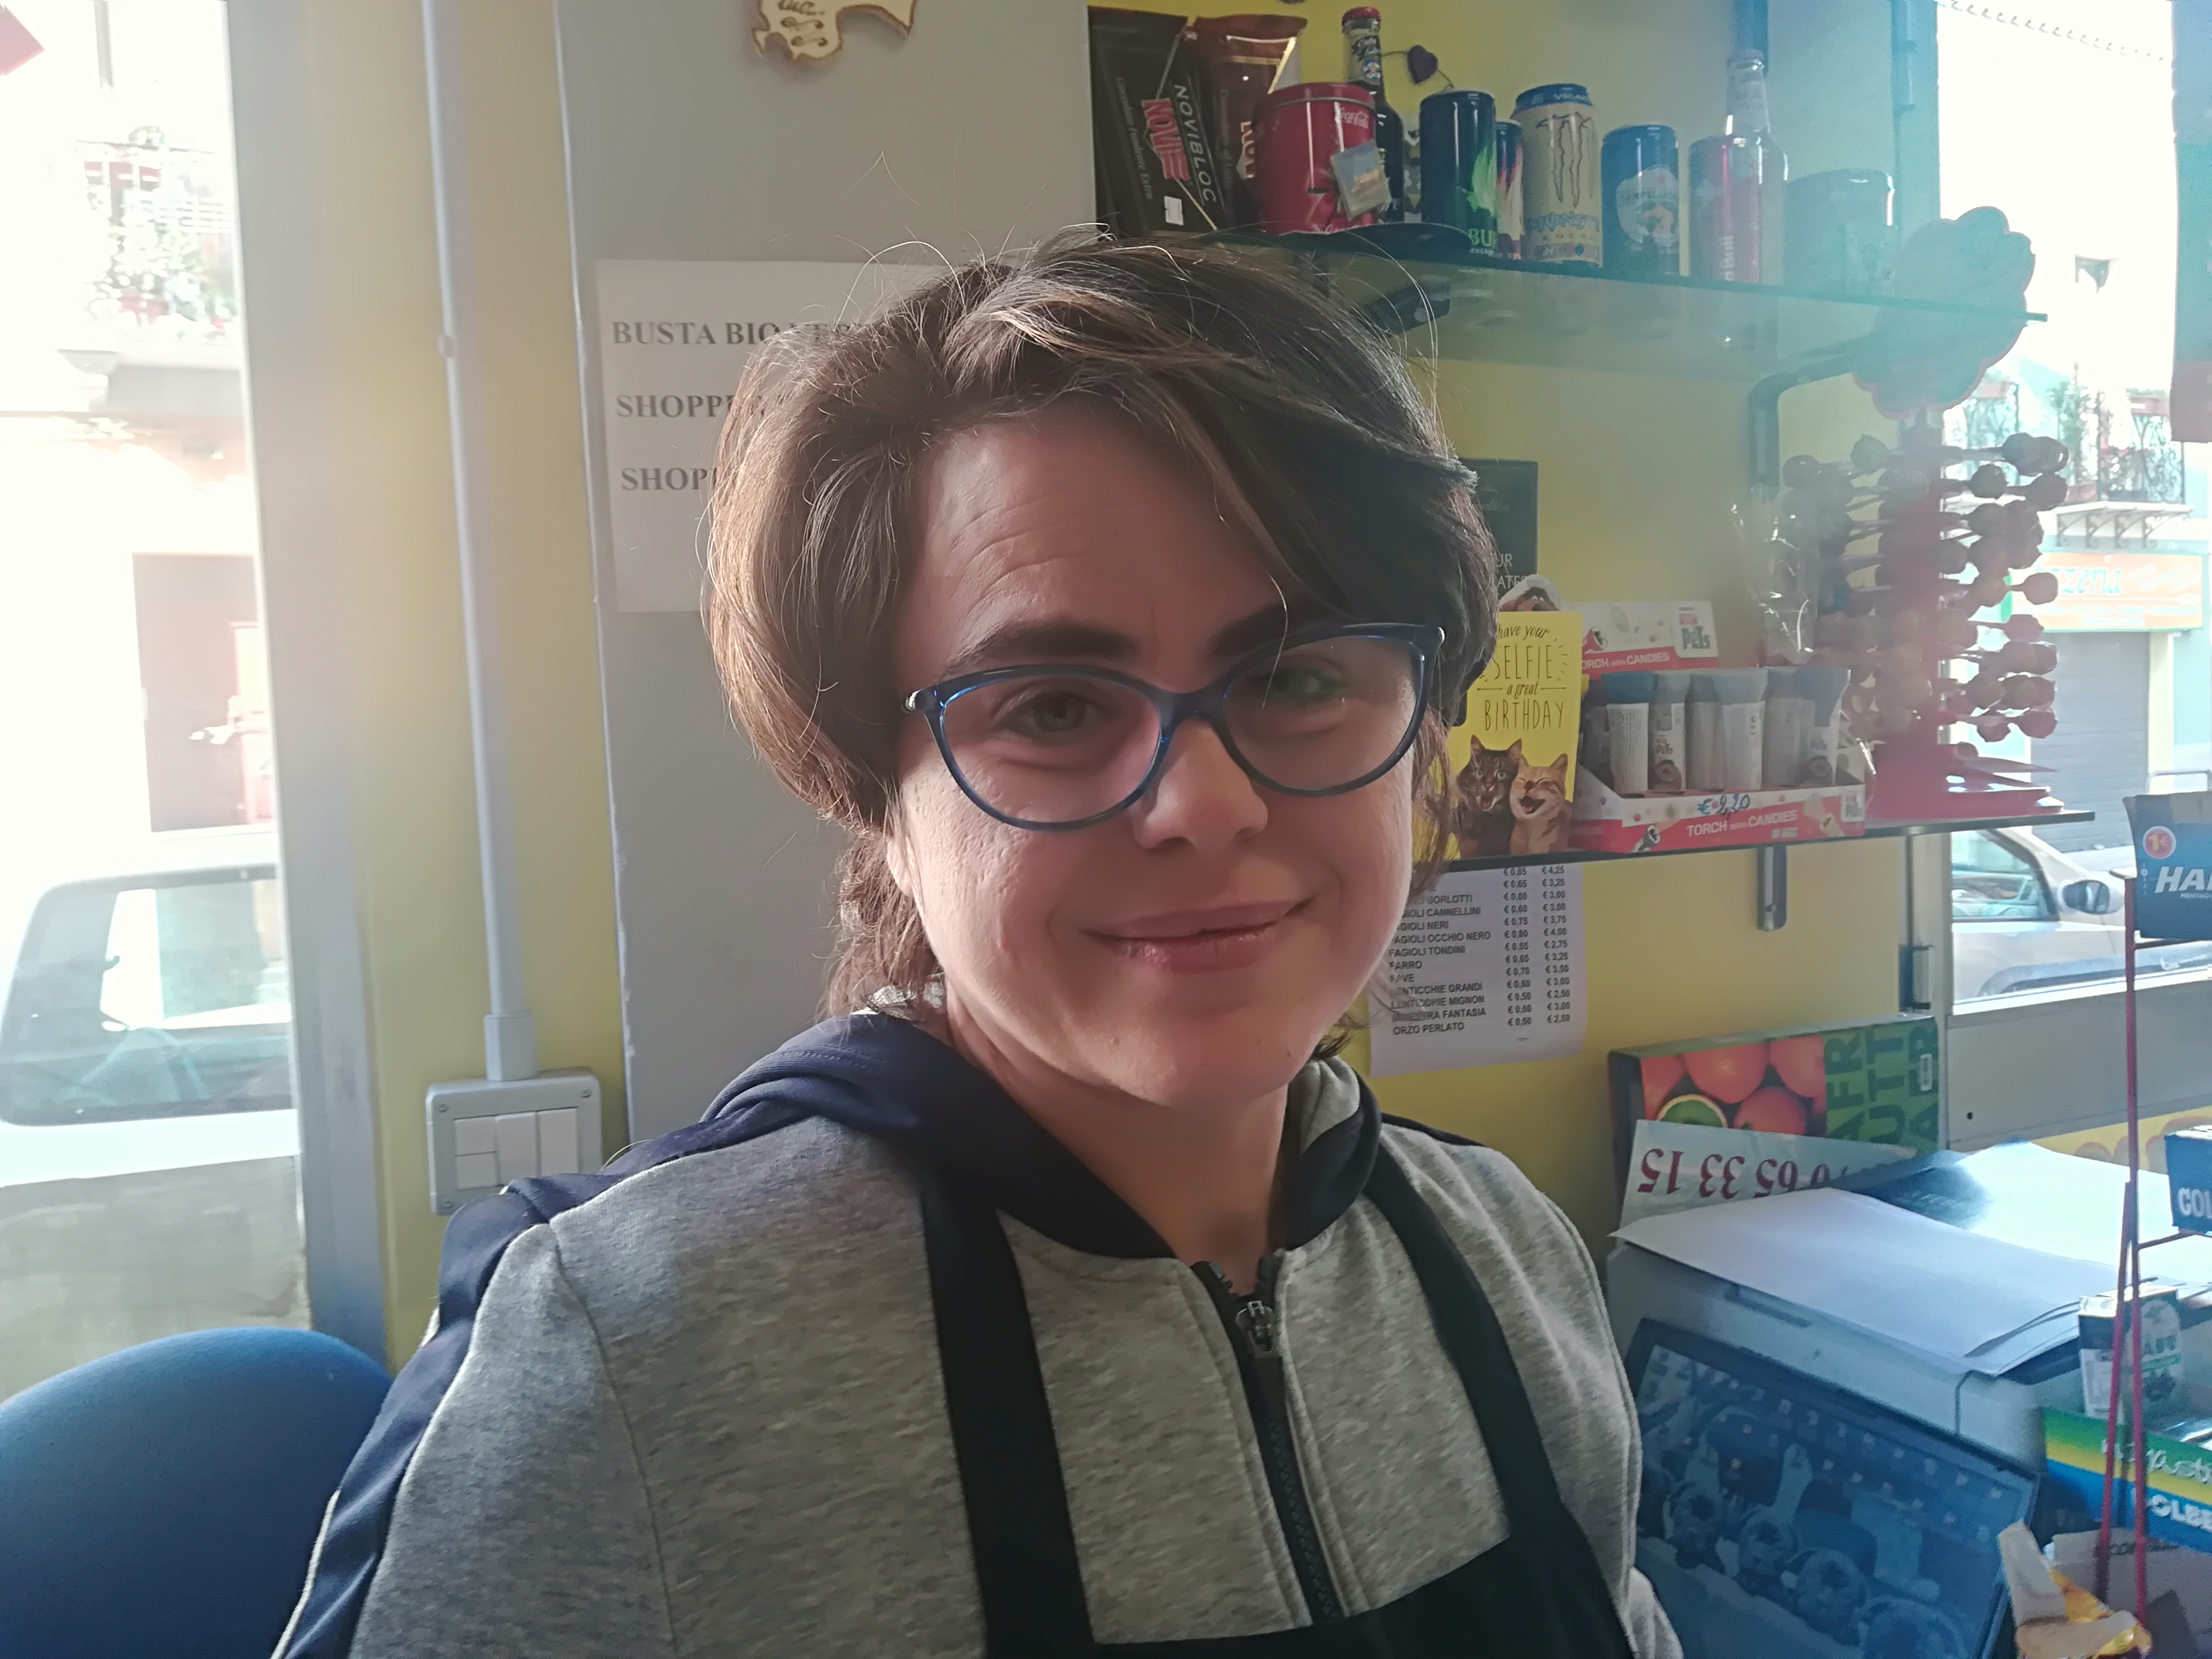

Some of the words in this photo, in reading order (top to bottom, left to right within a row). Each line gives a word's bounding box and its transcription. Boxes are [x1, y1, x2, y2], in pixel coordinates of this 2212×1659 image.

[1141, 98, 1185, 156] NOVI
[1173, 84, 1217, 203] NOVIBLOC
[612, 322, 717, 345] BUSTA
[1498, 624, 1521, 640] have
[1522, 625, 1550, 641] your
[1492, 644, 1553, 680] SELFIE
[1582, 657, 1609, 670] ORCH
[1626, 652, 1671, 665] CANDIES
[1506, 684, 1513, 696] a
[1514, 681, 1539, 700] great
[1485, 698, 1564, 731] BIRTHDAY
[1686, 819, 1729, 837] TORCH
[1748, 810, 1798, 828] CANDIES
[1427, 906, 1481, 917] CANNELLINI
[1397, 922, 1425, 931] GIOLI
[1427, 921, 1449, 929] NERI
[1511, 917, 1528, 926] 0,75
[1550, 915, 1566, 925] 3,75
[1428, 933, 1464, 942] OCCHIO
[1466, 932, 1491, 940] NERO
[1389, 948, 1426, 957] FAGIOLI
[1428, 945, 1466, 955] TONDINI
[1389, 961, 1422, 970] FARRO
[1390, 974, 1415, 983] FAVE
[1513, 966, 1530, 977] 0,70
[1449, 983, 1483, 993] GRANDI
[1449, 995, 1485, 1006] MIGNON
[1515, 992, 1531, 1001] 0,50
[1443, 1007, 1486, 1018] FANTASIA
[1393, 1025, 1420, 1035] ORZO
[1422, 1022, 1464, 1033] PERLATO
[1637, 1148, 1686, 1195] 15
[1699, 1153, 1745, 1200] 33
